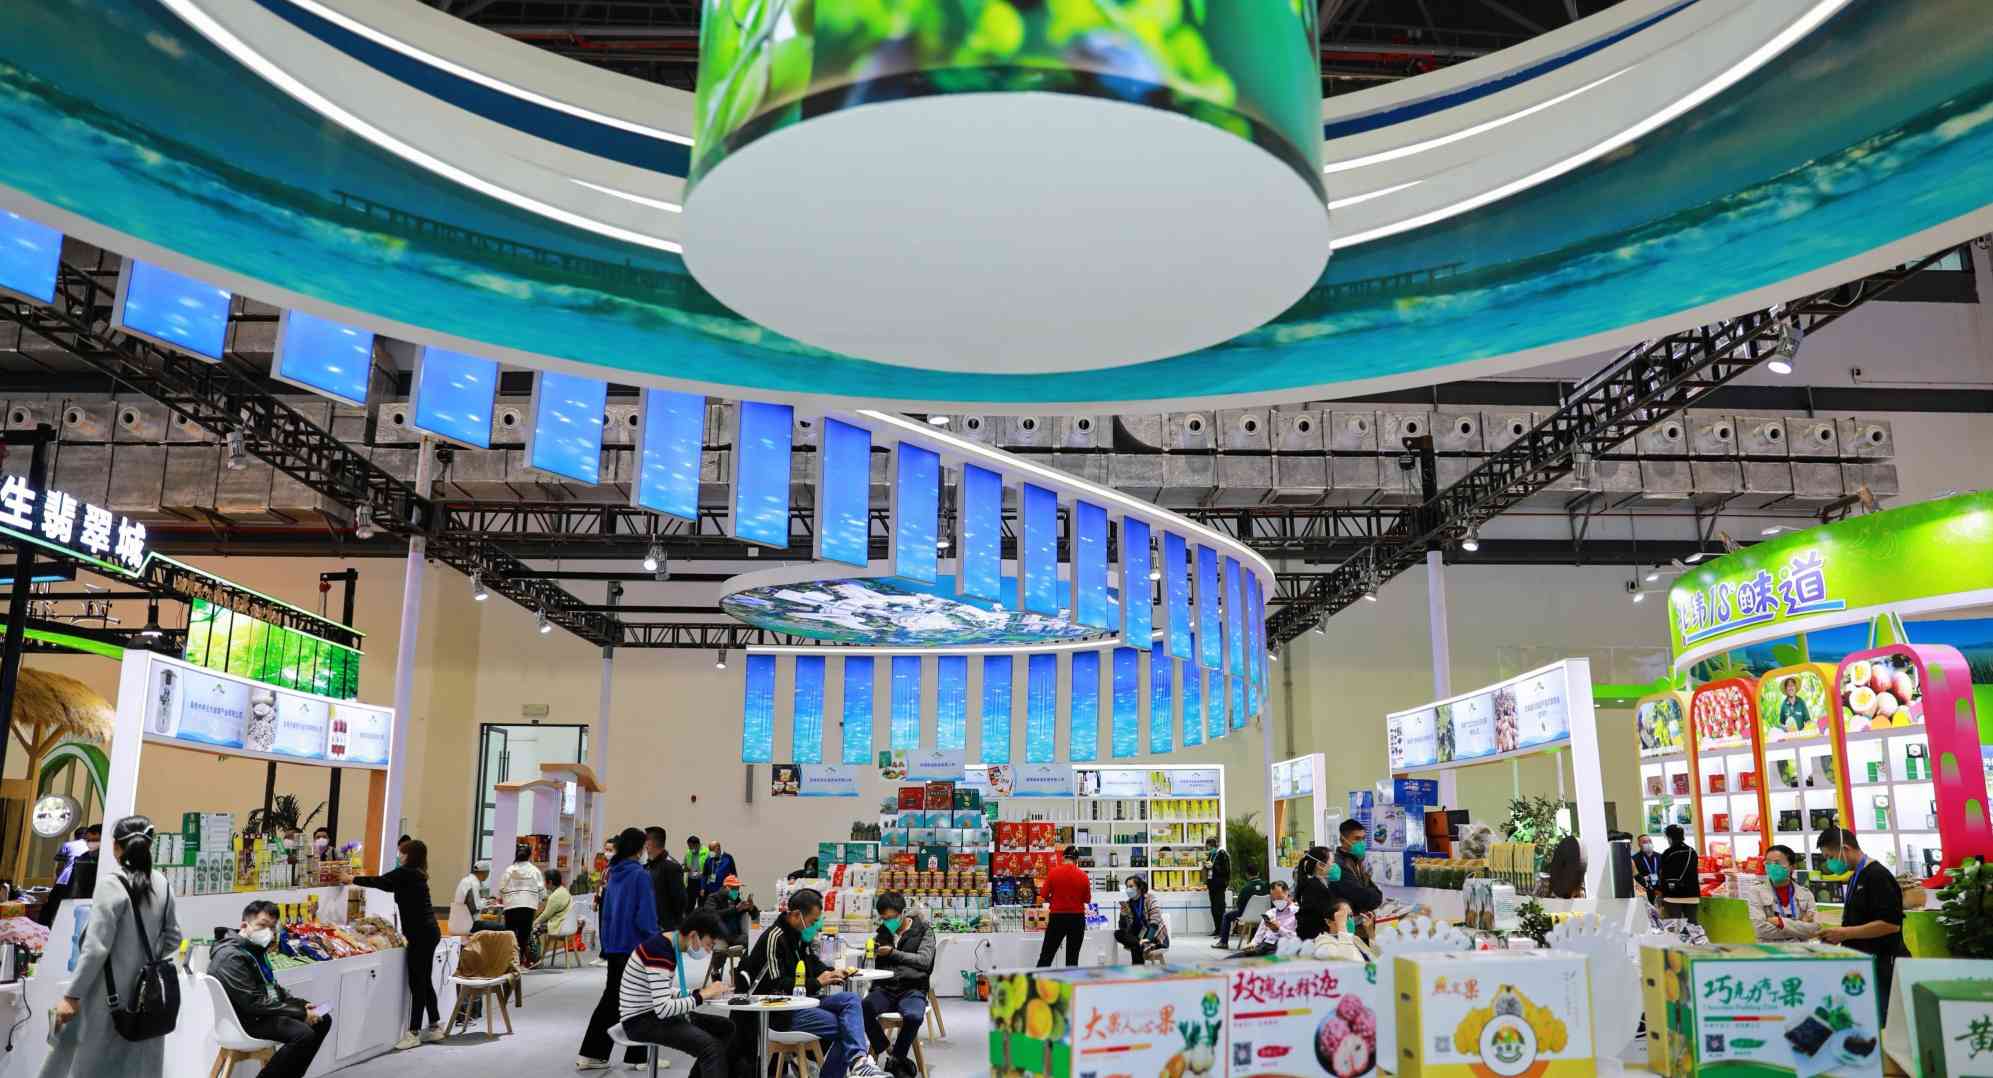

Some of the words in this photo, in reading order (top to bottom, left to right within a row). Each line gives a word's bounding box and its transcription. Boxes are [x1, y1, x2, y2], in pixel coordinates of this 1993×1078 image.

[0, 474, 147, 568] 生翡翠城
[1231, 968, 1342, 1005] 玫瑰红释迦
[1703, 975, 1806, 1008] 巧克力布丁果
[1082, 1003, 1176, 1040] 大果人心果
